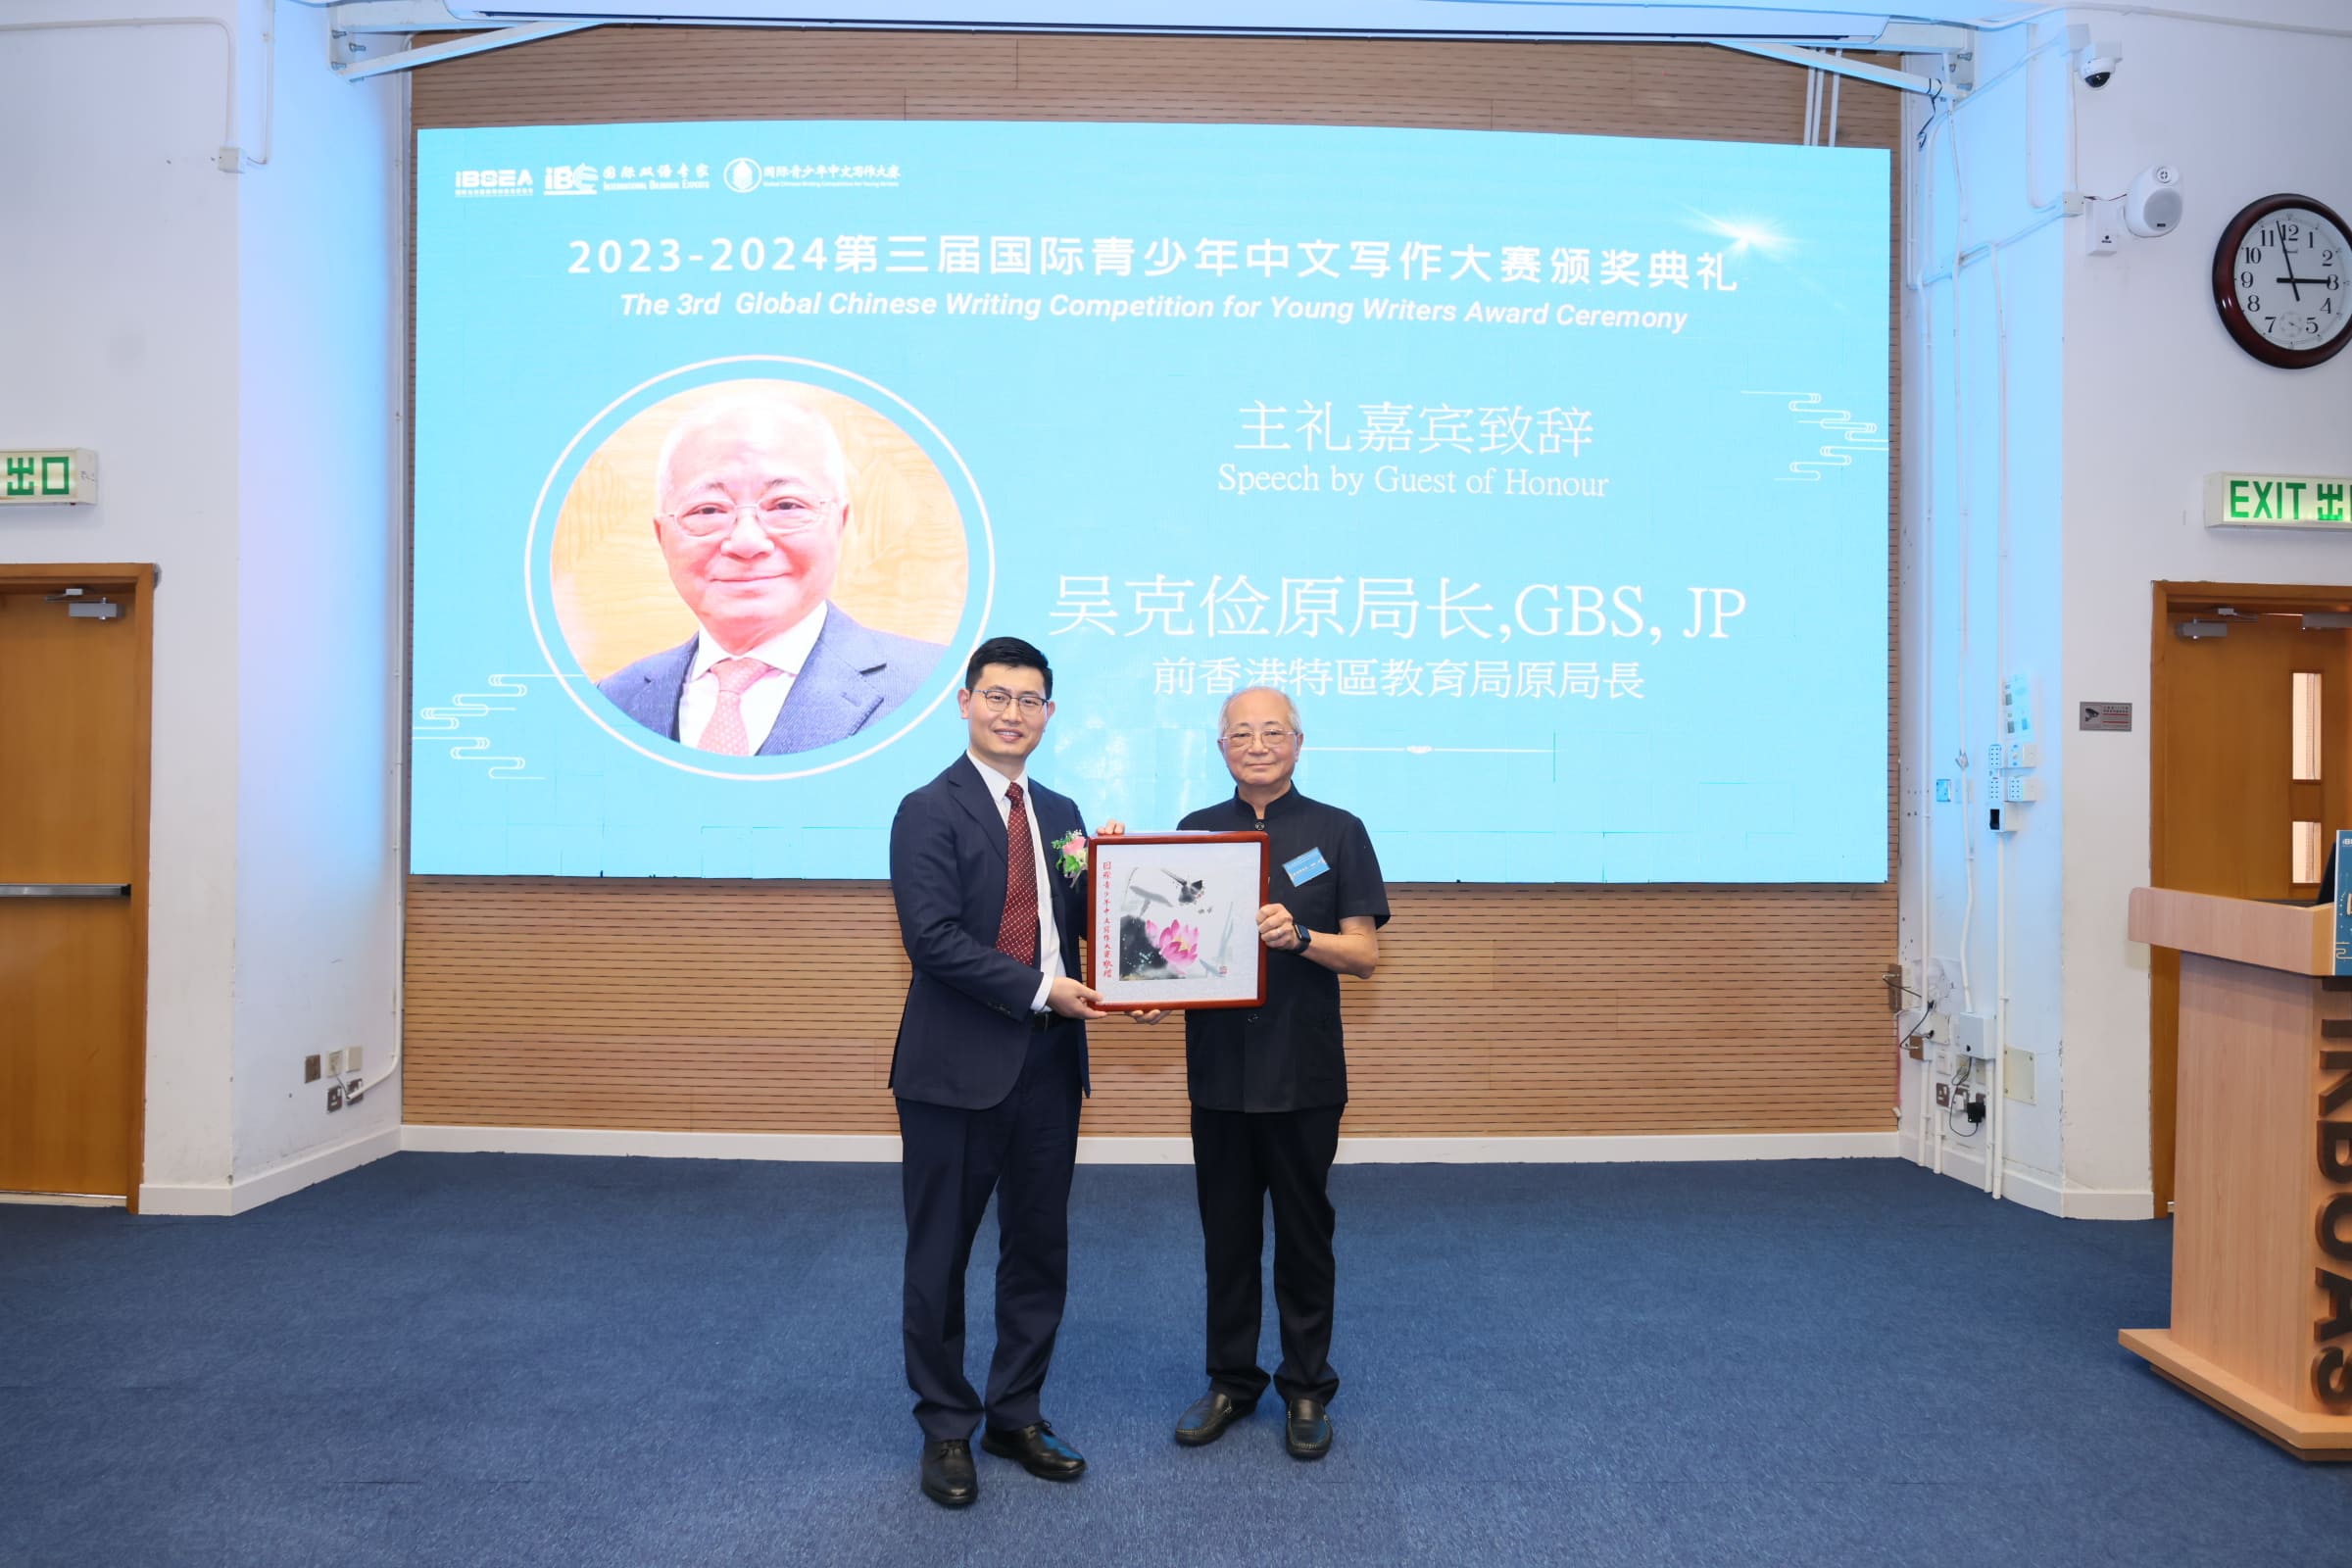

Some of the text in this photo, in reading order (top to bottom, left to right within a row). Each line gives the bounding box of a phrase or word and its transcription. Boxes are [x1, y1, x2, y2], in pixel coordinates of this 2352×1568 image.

[2261, 229, 2274, 247] 11
[2308, 231, 2314, 249] 1
[567, 233, 1739, 292] 2023-2024第三届国际青少年中文写作大赛颁奖典礼
[2245, 247, 2262, 265] 10
[2322, 250, 2333, 267] 2
[2240, 271, 2254, 288] 9
[2247, 295, 2261, 312] 8
[2320, 297, 2331, 315] 4
[620, 292, 1690, 334] The 3rd Global Chinese Writing Competition for Young Writers Award Ceremony
[2264, 317, 2277, 334] 7
[2305, 317, 2319, 334] 5
[1233, 399, 1594, 458] 主礼嘉宾致辞
[7, 457, 70, 496] 出口
[1217, 464, 1610, 497] Speech by Guest of Honour
[2230, 480, 2352, 521] EXIT 出
[1683, 587, 1747, 639] JP
